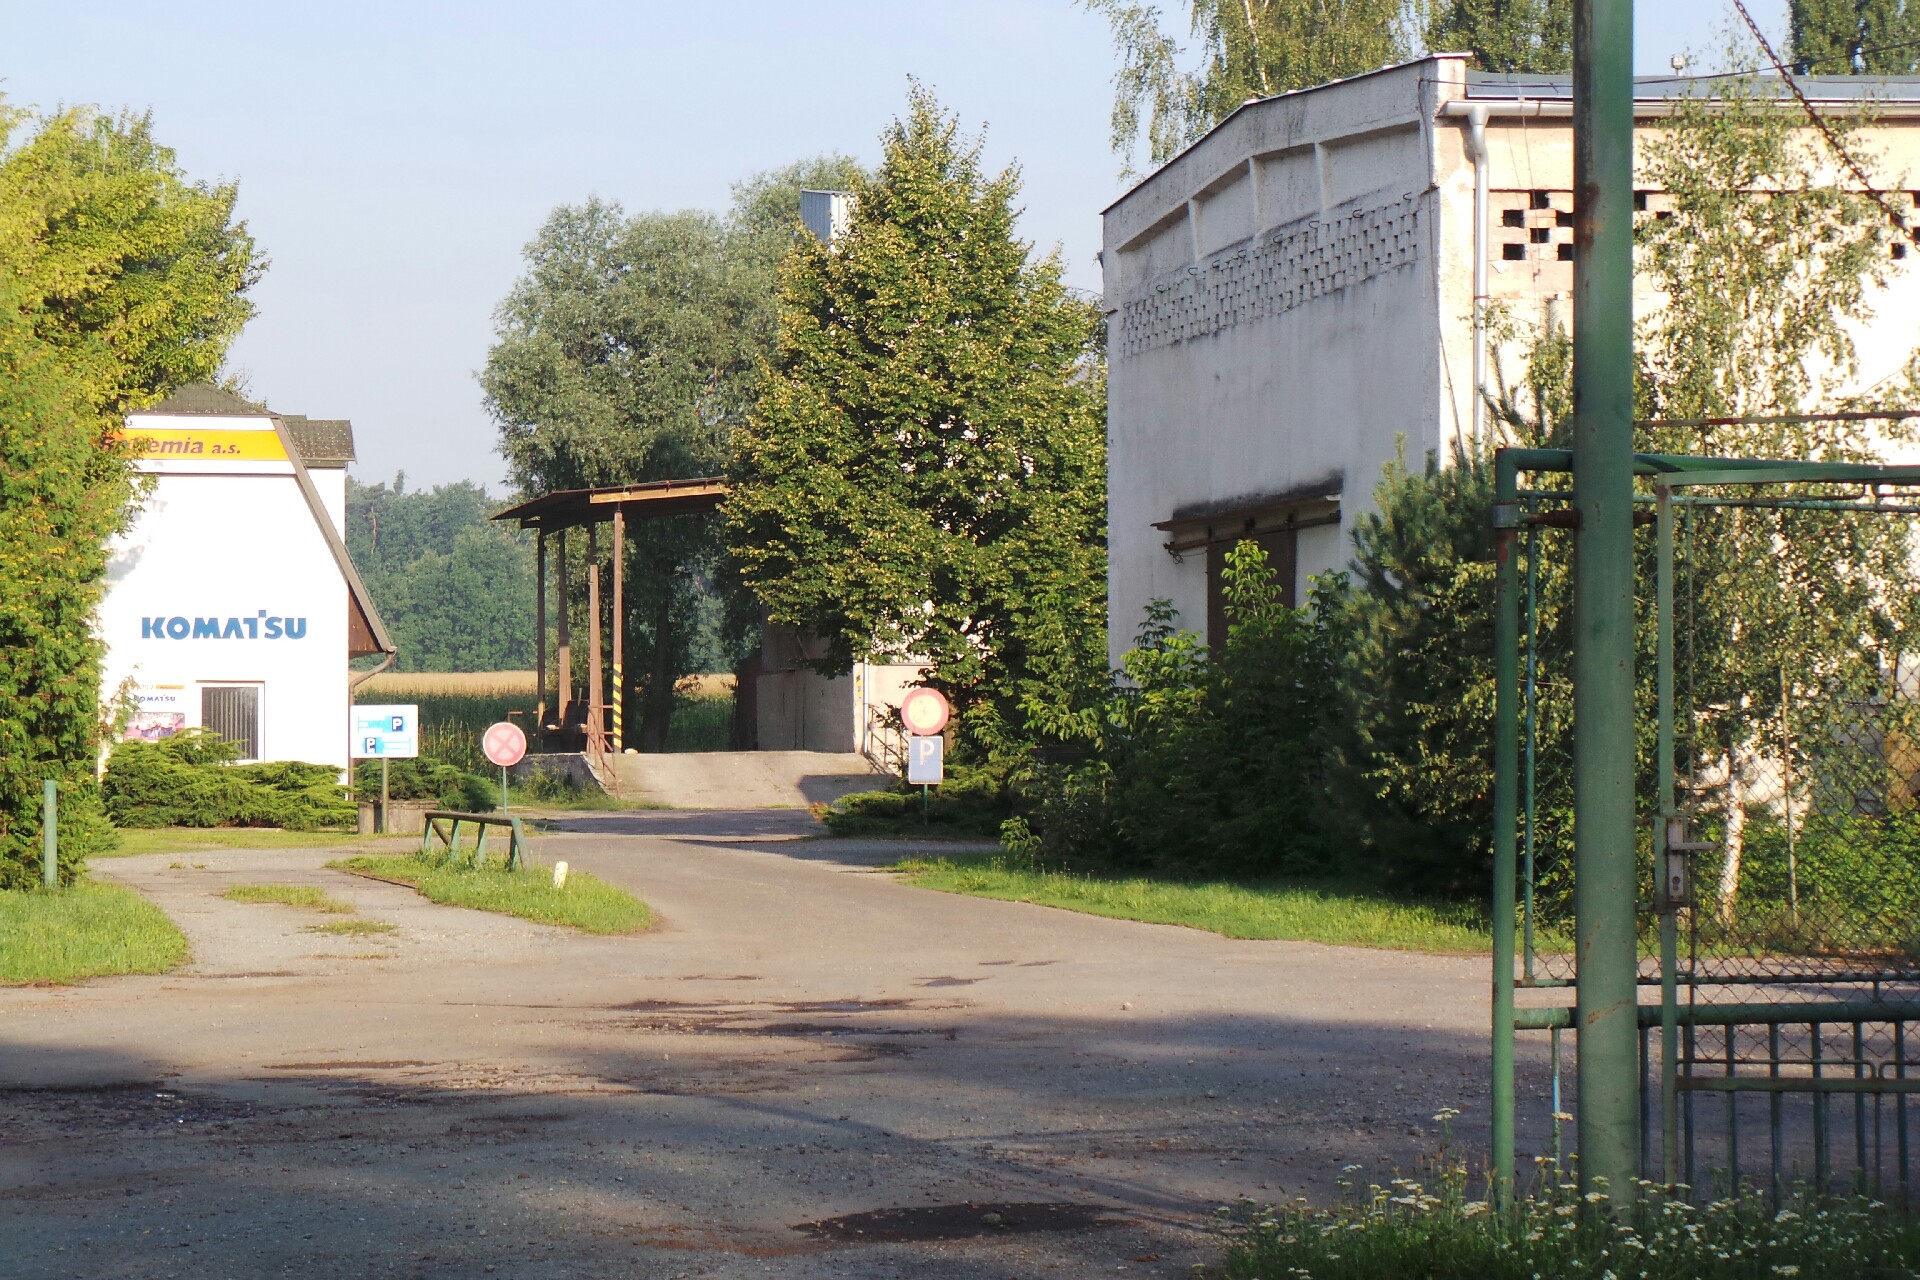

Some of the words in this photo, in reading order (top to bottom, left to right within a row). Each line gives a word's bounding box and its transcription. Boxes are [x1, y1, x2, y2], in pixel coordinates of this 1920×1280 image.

[211, 444, 241, 454] a.s.
[141, 609, 307, 640] KOMATSU
[134, 694, 176, 702] OMATSU
[392, 717, 403, 730] P
[919, 739, 935, 766] P
